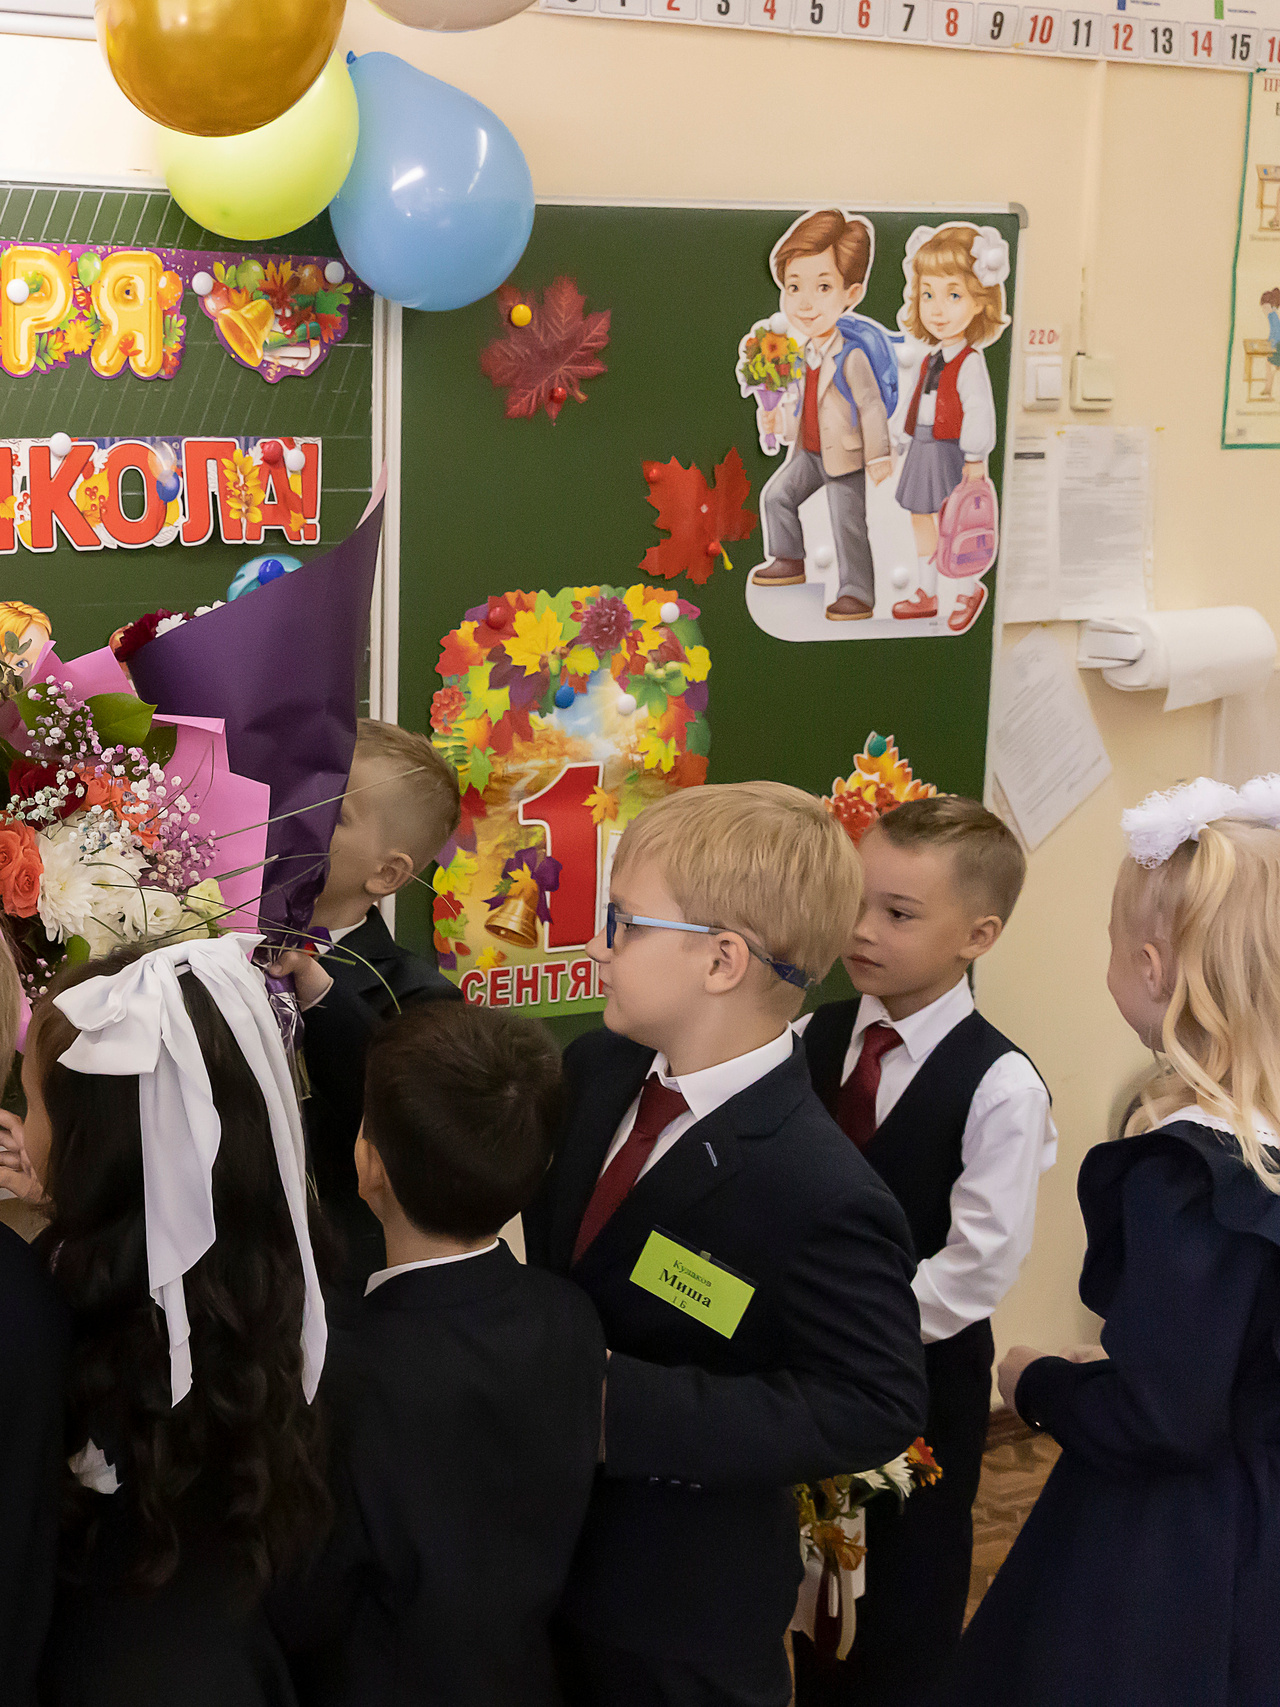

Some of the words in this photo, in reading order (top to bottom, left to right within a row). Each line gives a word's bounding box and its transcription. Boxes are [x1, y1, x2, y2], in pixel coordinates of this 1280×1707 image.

[763, 0, 776, 20] 4
[810, 0, 823, 24] 5
[858, 0, 870, 28] 6
[903, 4, 915, 32] 7
[945, 8, 959, 36] 8
[990, 11, 1004, 40] 9
[1028, 14, 1054, 44] 10
[1072, 18, 1092, 47] 11
[1112, 23, 1133, 51] 12
[1151, 27, 1173, 54] 13
[1191, 30, 1213, 57] 14
[1230, 34, 1251, 61] 15
[1268, 36, 1280, 63] 1
[1029, 329, 1055, 345] 220
[518, 761, 604, 953] 1
[459, 958, 606, 1009] СЕНТЯ
[658, 1268, 712, 1309] Миша
[679, 1299, 688, 1309] Б
